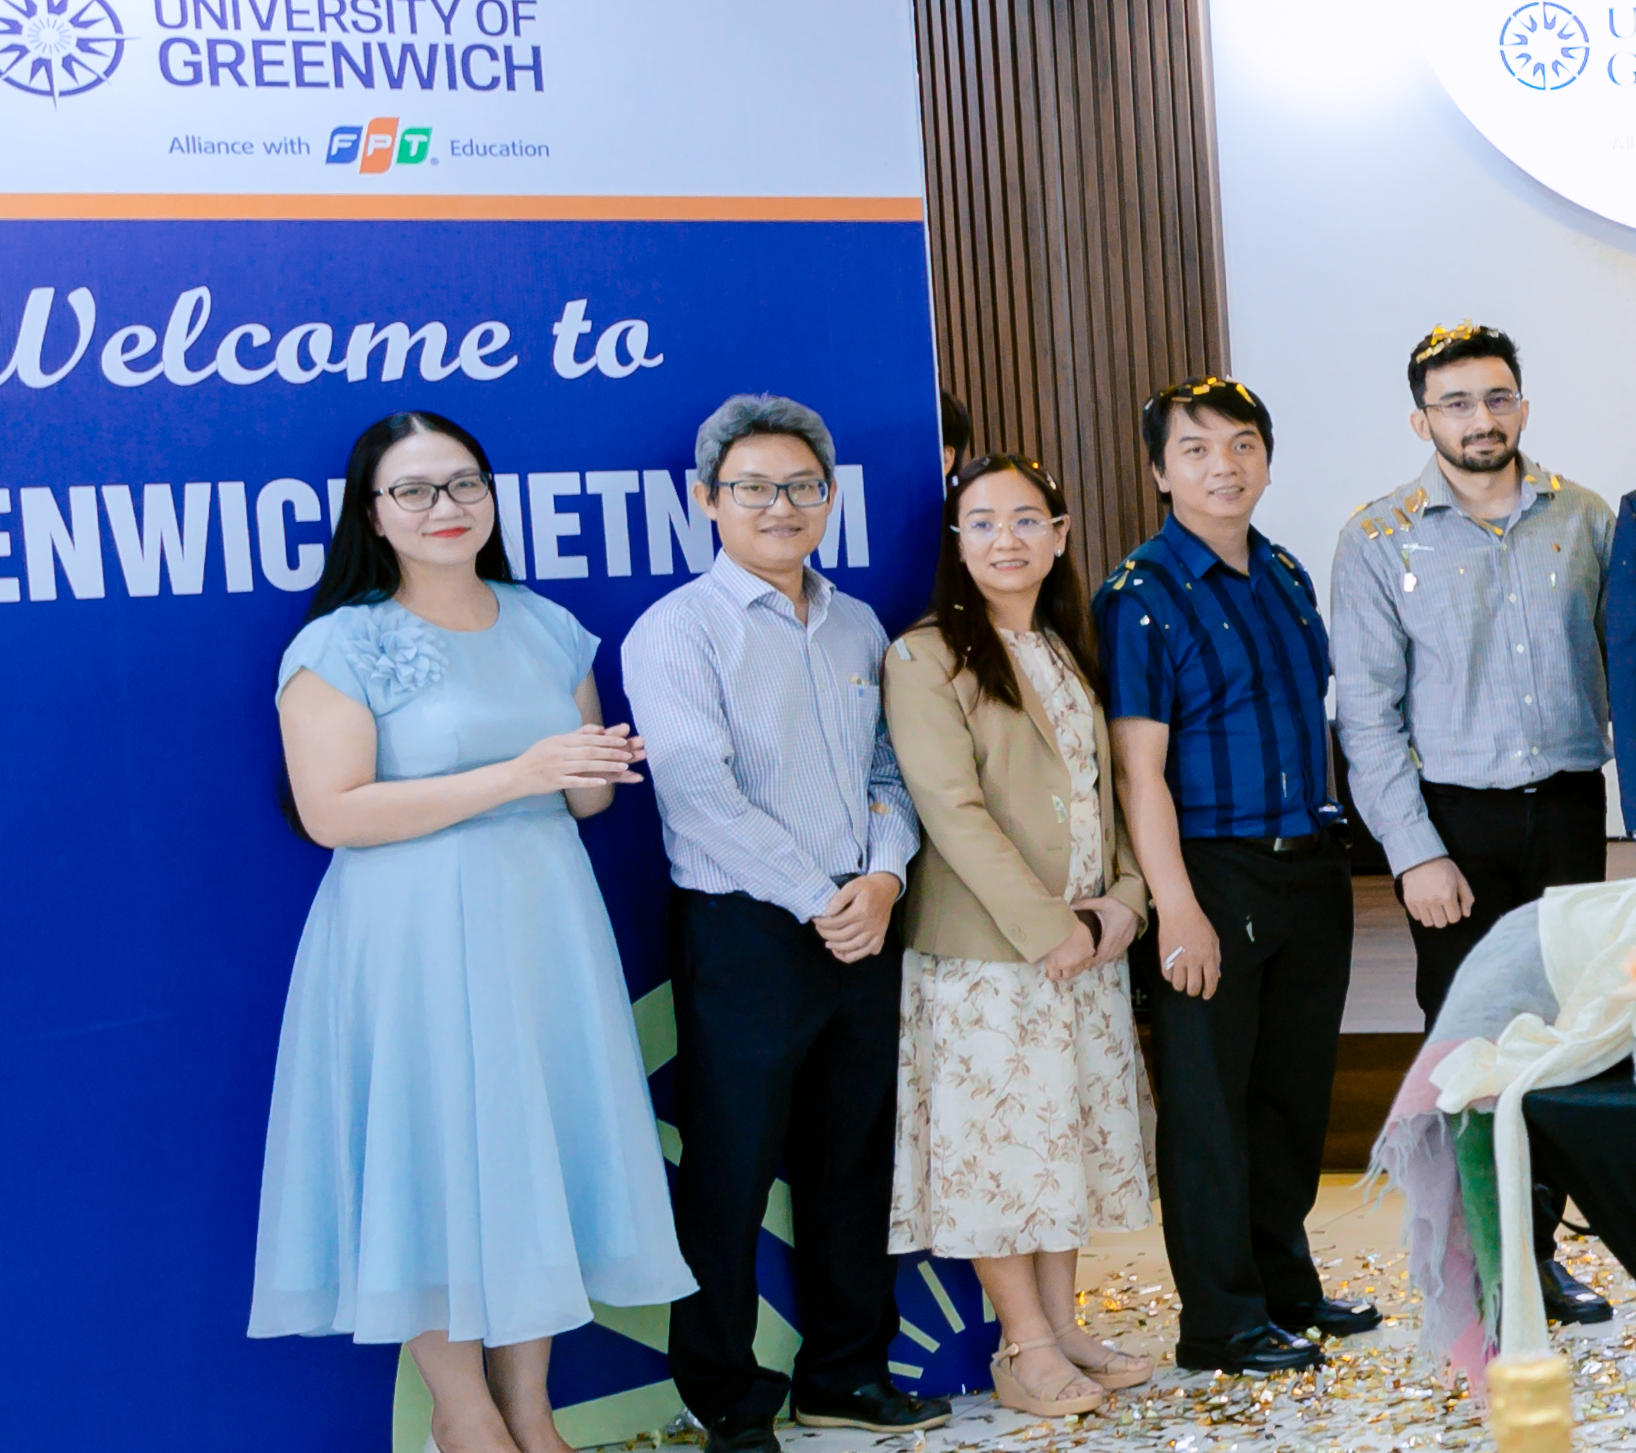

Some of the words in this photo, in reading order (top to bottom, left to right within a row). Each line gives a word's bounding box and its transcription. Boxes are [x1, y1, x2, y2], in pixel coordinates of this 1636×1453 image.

[158, 37, 545, 94] GREENWICH
[168, 135, 256, 157] Alliance
[262, 135, 311, 157] with
[326, 125, 433, 166] FPT
[450, 138, 550, 158] Education
[552, 298, 664, 381] to
